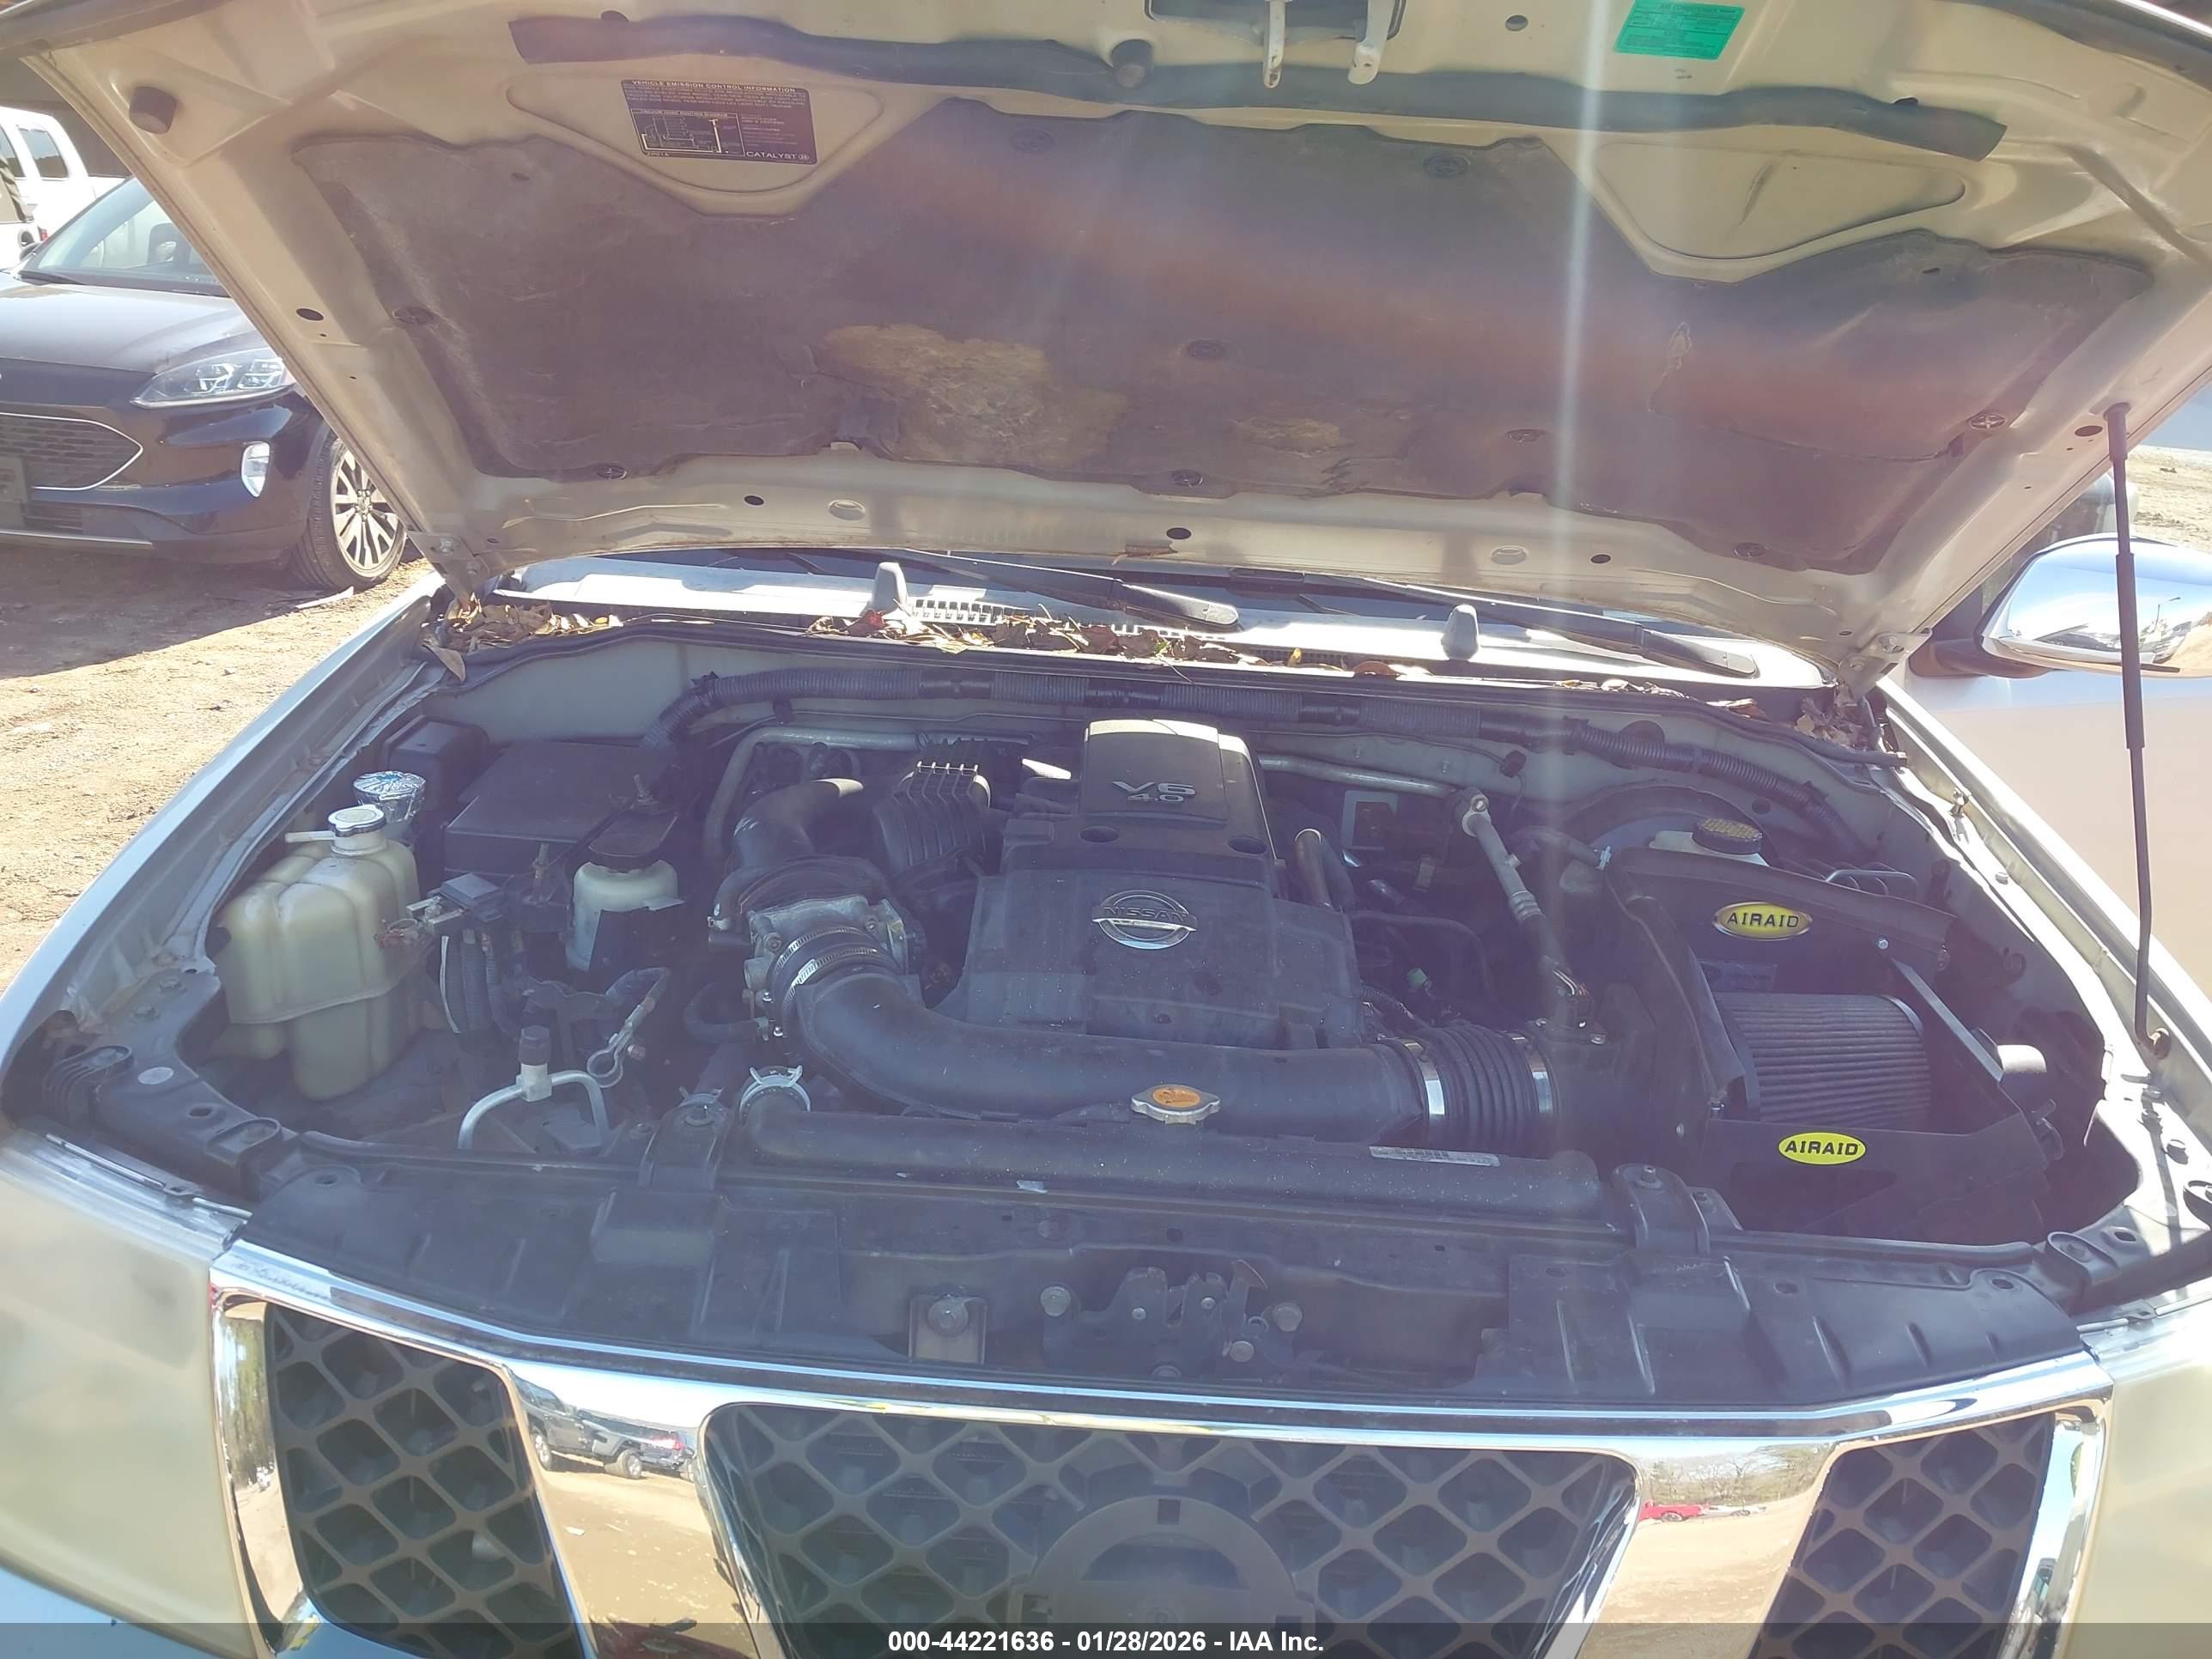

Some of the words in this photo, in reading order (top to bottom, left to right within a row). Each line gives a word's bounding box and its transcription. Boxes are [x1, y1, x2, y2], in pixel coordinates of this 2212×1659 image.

[1112, 781, 1196, 795] V6
[1127, 793, 1184, 802] 4.0
[1103, 907, 1187, 921] NISSAN
[1727, 912, 1799, 927] AIRAID
[1784, 1139, 1859, 1156] AIRAID
